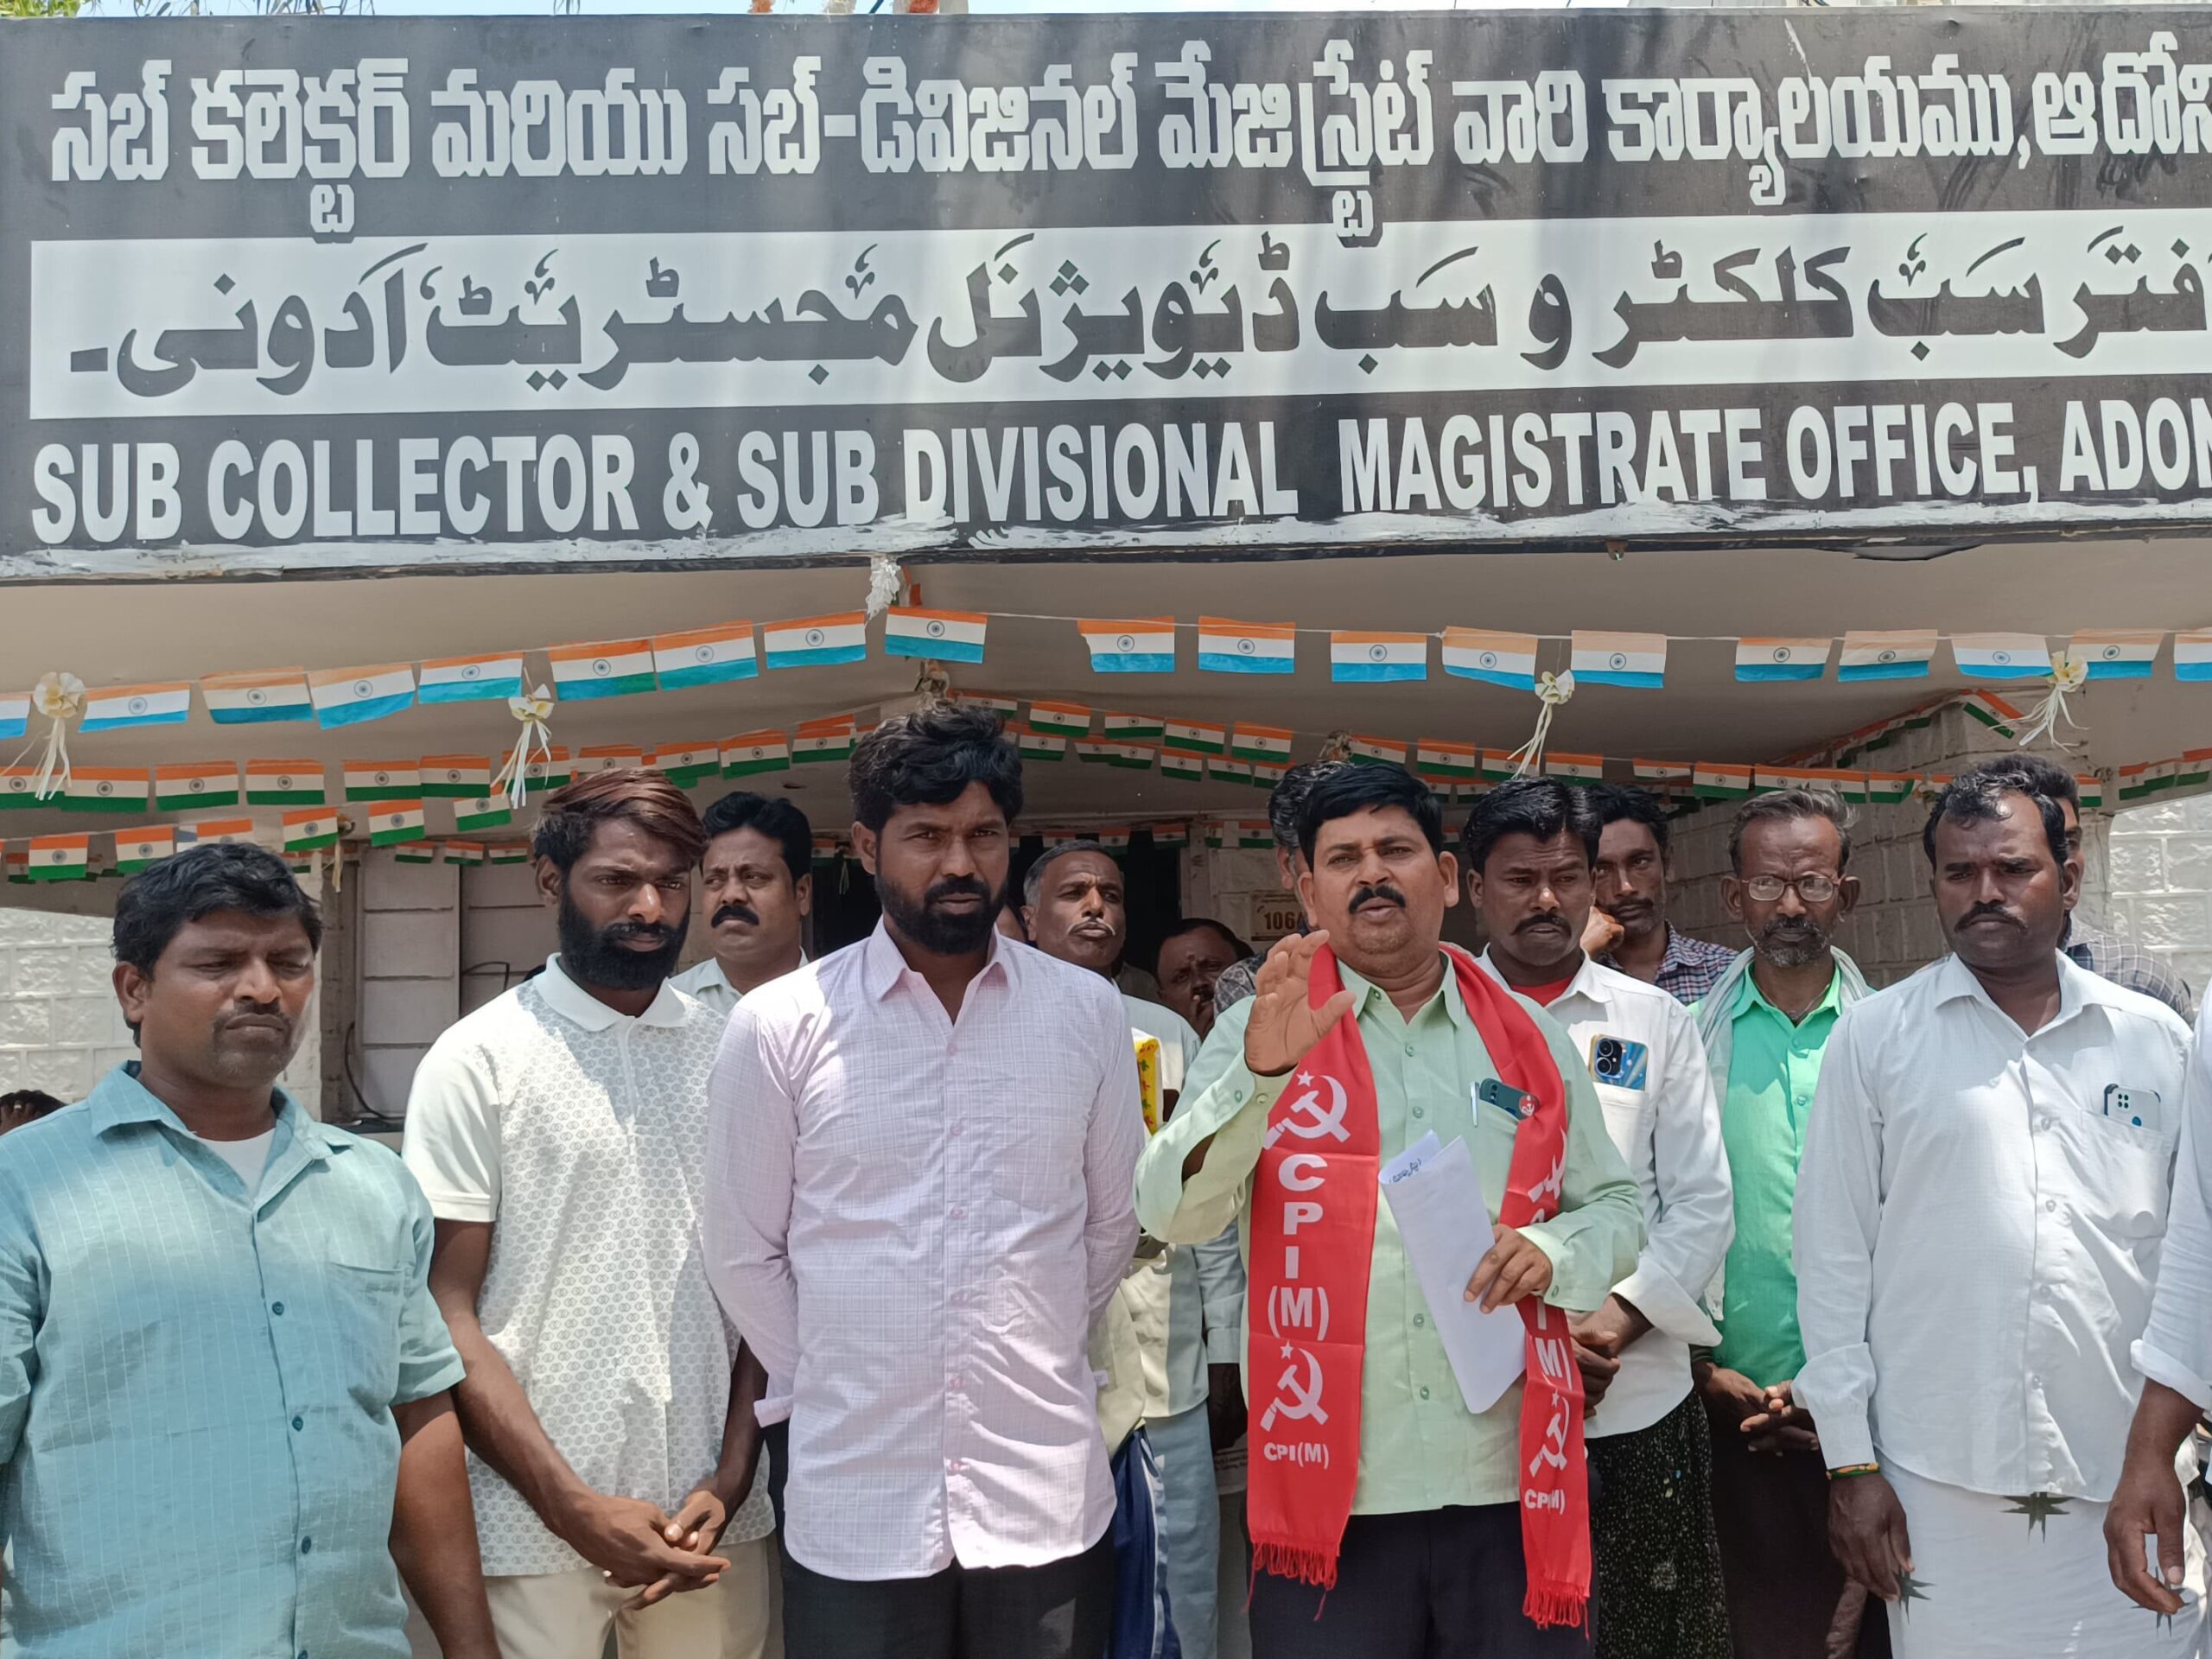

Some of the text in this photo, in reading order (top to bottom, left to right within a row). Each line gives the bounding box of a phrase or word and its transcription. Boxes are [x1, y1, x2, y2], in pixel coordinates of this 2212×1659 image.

[52, 60, 172, 181] సబ్
[191, 58, 410, 232] కలెక్టర్
[31, 442, 181, 544] SUB
[207, 434, 640, 540] COLLECTOR
[663, 432, 714, 534] &
[738, 429, 880, 530] SUB
[903, 421, 1300, 524] DIVISIONAL
[1338, 408, 1767, 513] MAGISTRATE
[1786, 402, 2039, 515] OFFICE,
[1263, 1441, 1329, 1469] CPI(M)
